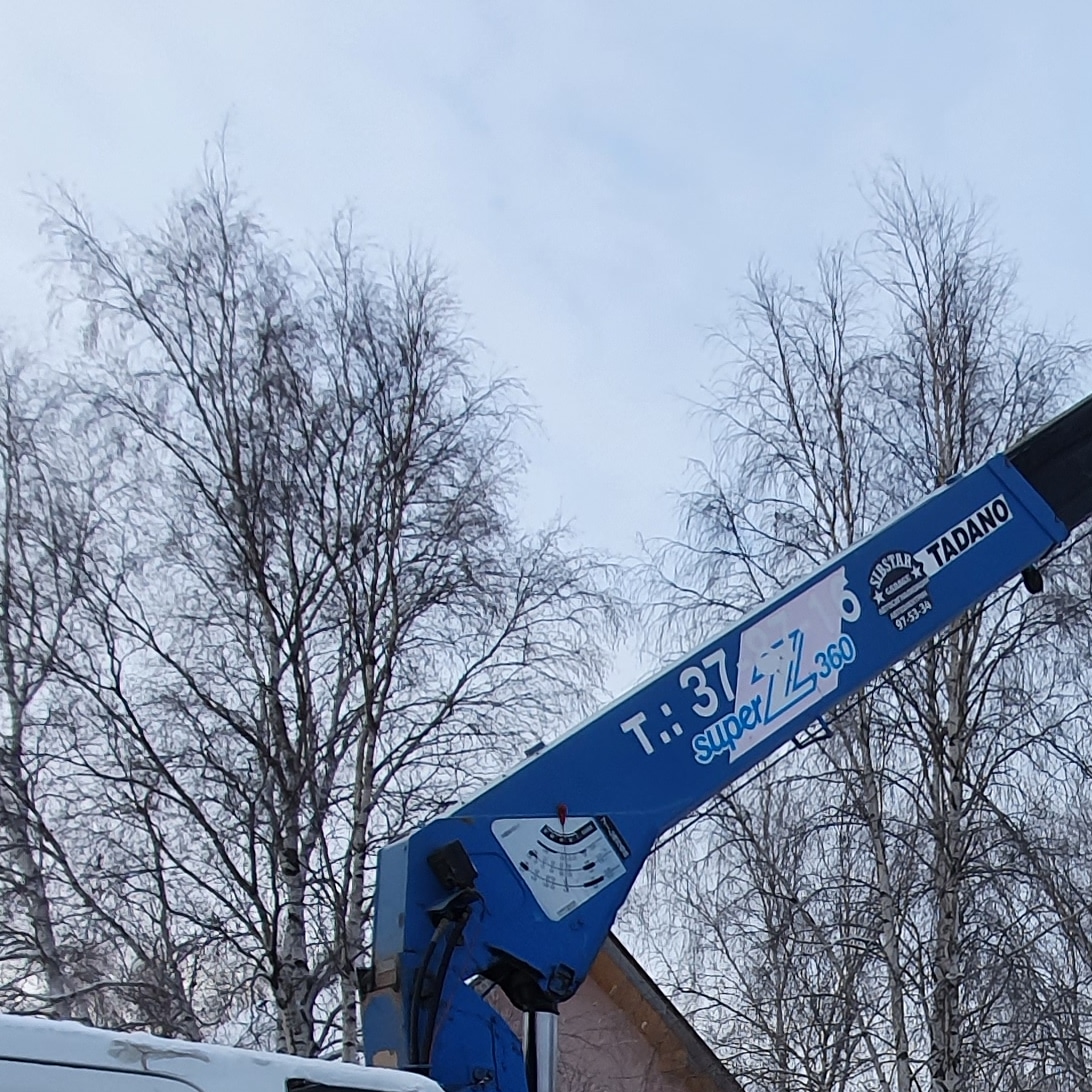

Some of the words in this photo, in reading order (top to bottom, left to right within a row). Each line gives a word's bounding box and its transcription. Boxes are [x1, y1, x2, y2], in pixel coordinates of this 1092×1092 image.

[926, 499, 1009, 567] TADANO
[869, 552, 913, 589] SIBSTAR
[895, 600, 932, 630] 97-53-34
